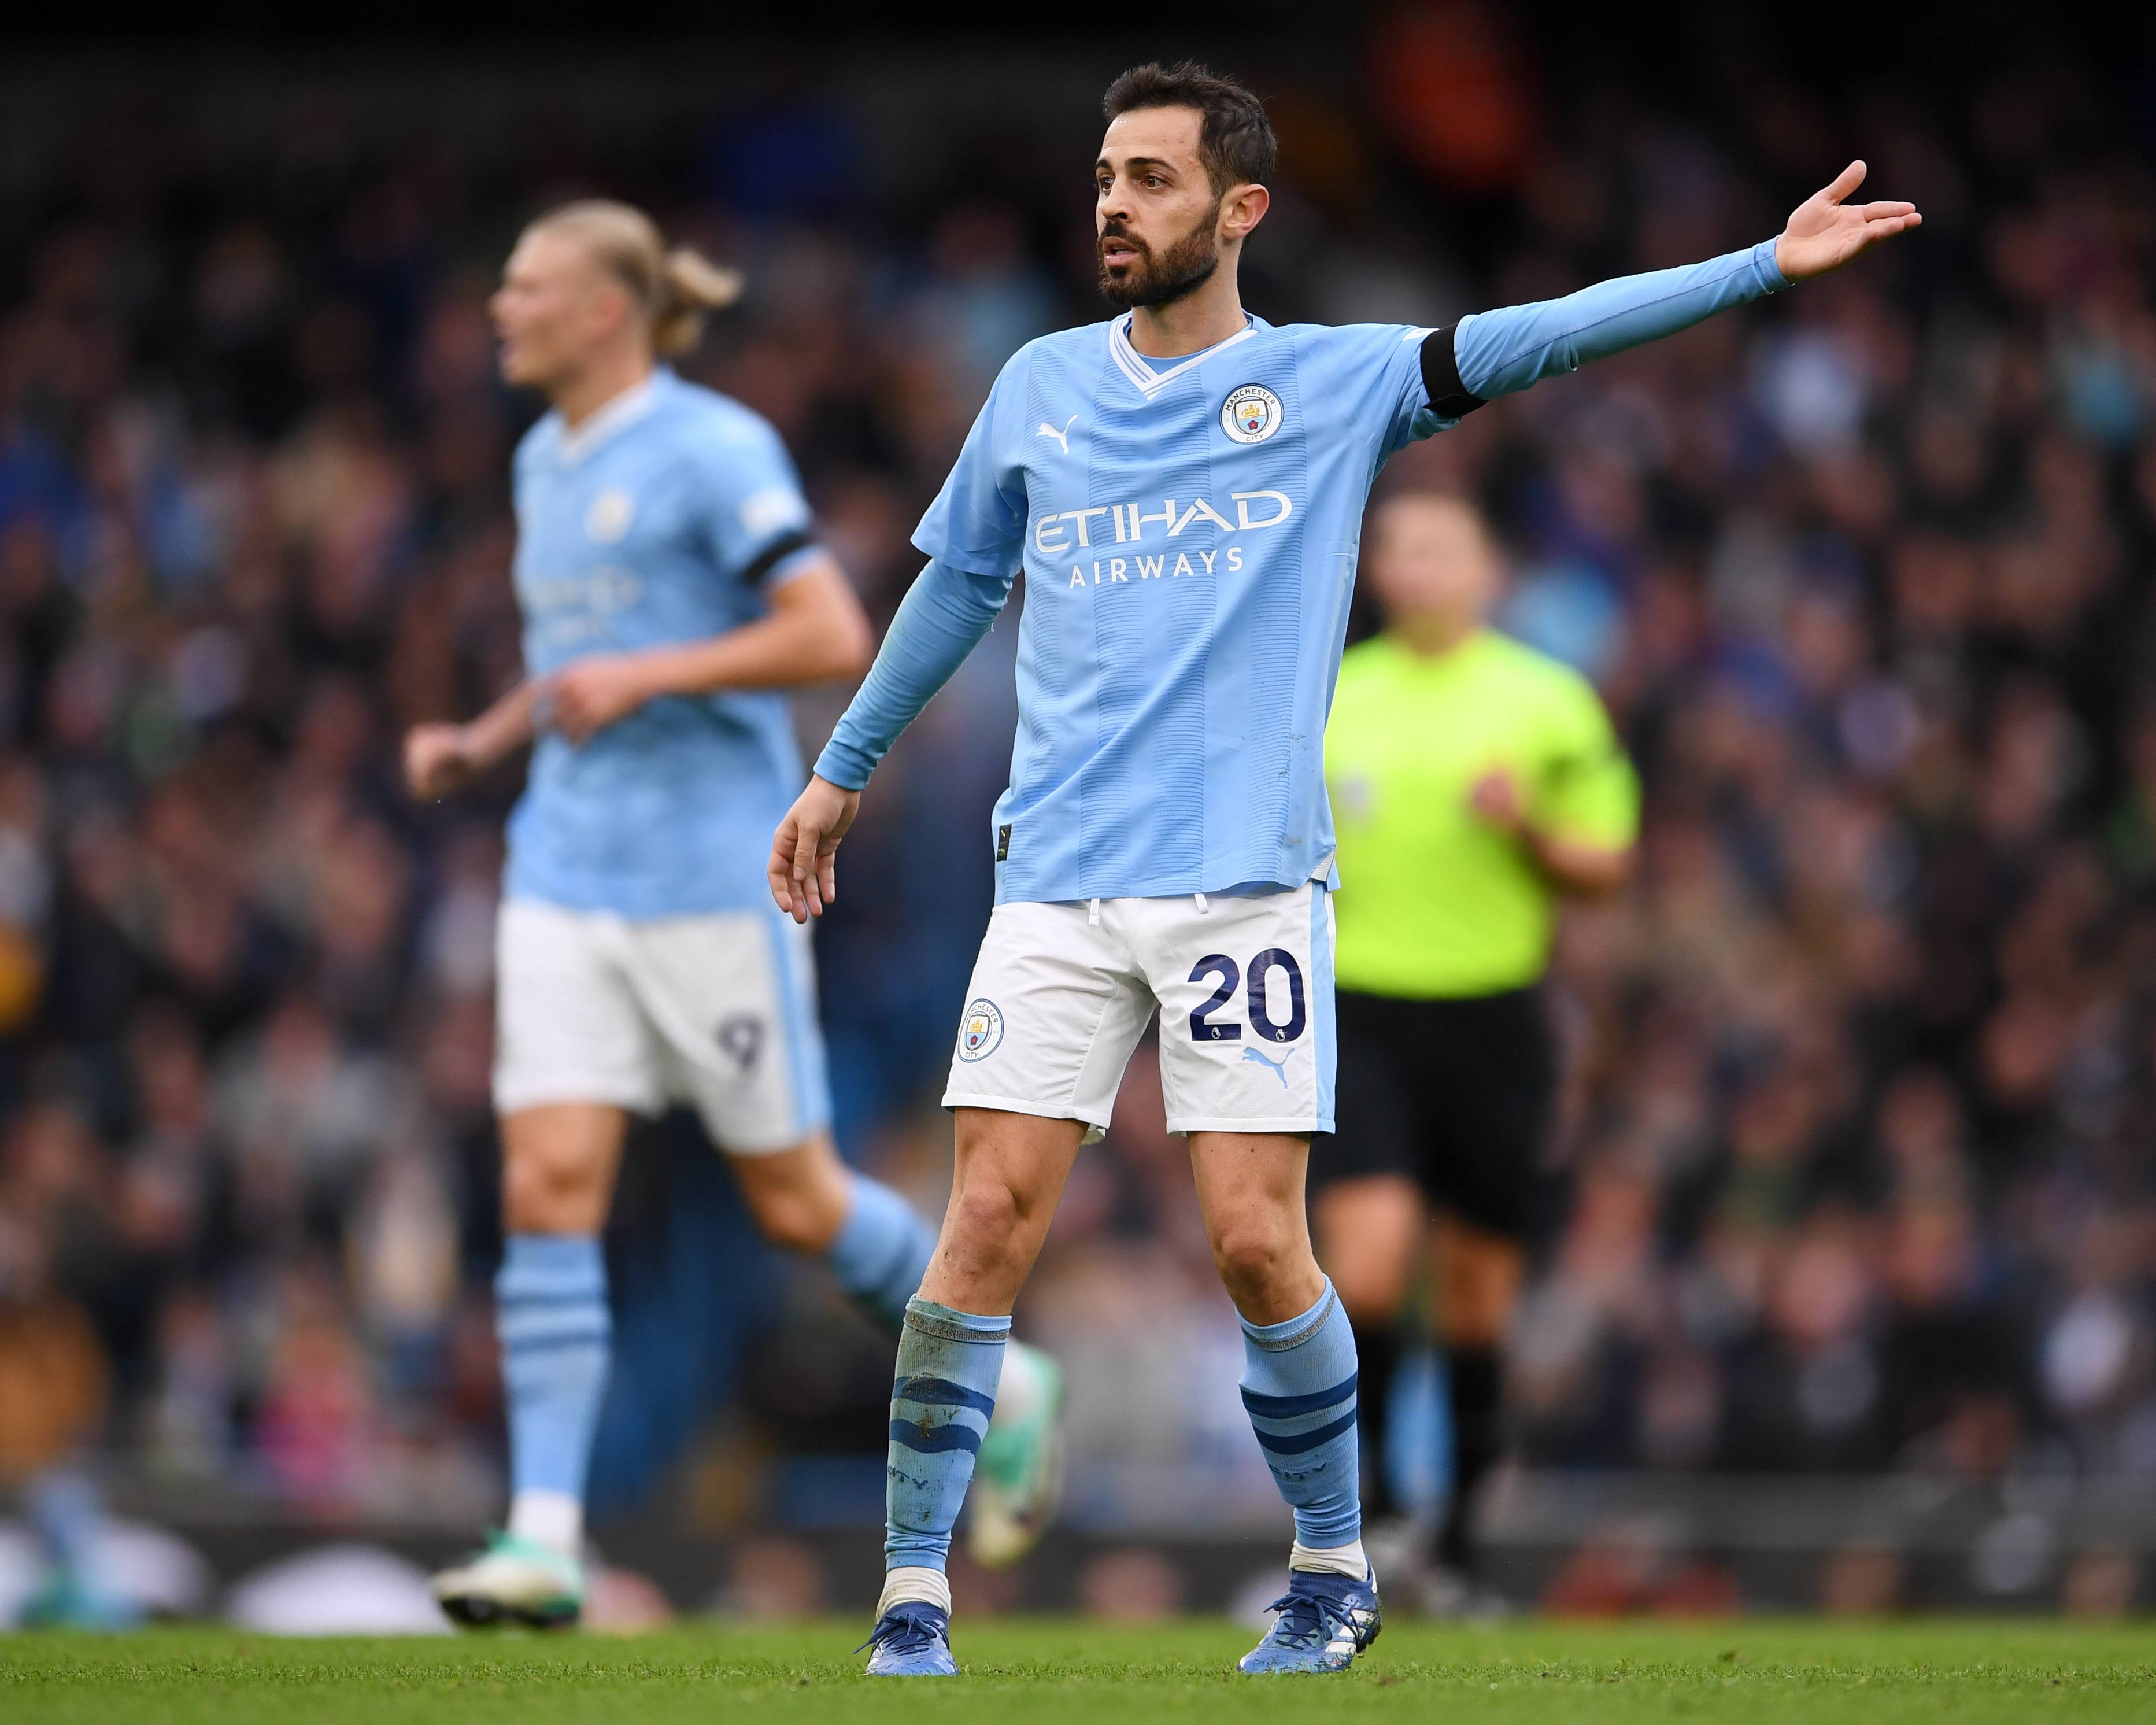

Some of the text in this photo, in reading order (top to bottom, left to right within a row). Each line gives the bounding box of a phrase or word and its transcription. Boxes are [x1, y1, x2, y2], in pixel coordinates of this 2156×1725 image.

[1226, 389, 1275, 411] MANCHESTER
[1036, 490, 1293, 553] ETIHAD
[1069, 546, 1244, 589] AIRWAYS
[1187, 947, 1306, 1043] 20
[713, 1012, 767, 1072] 9
